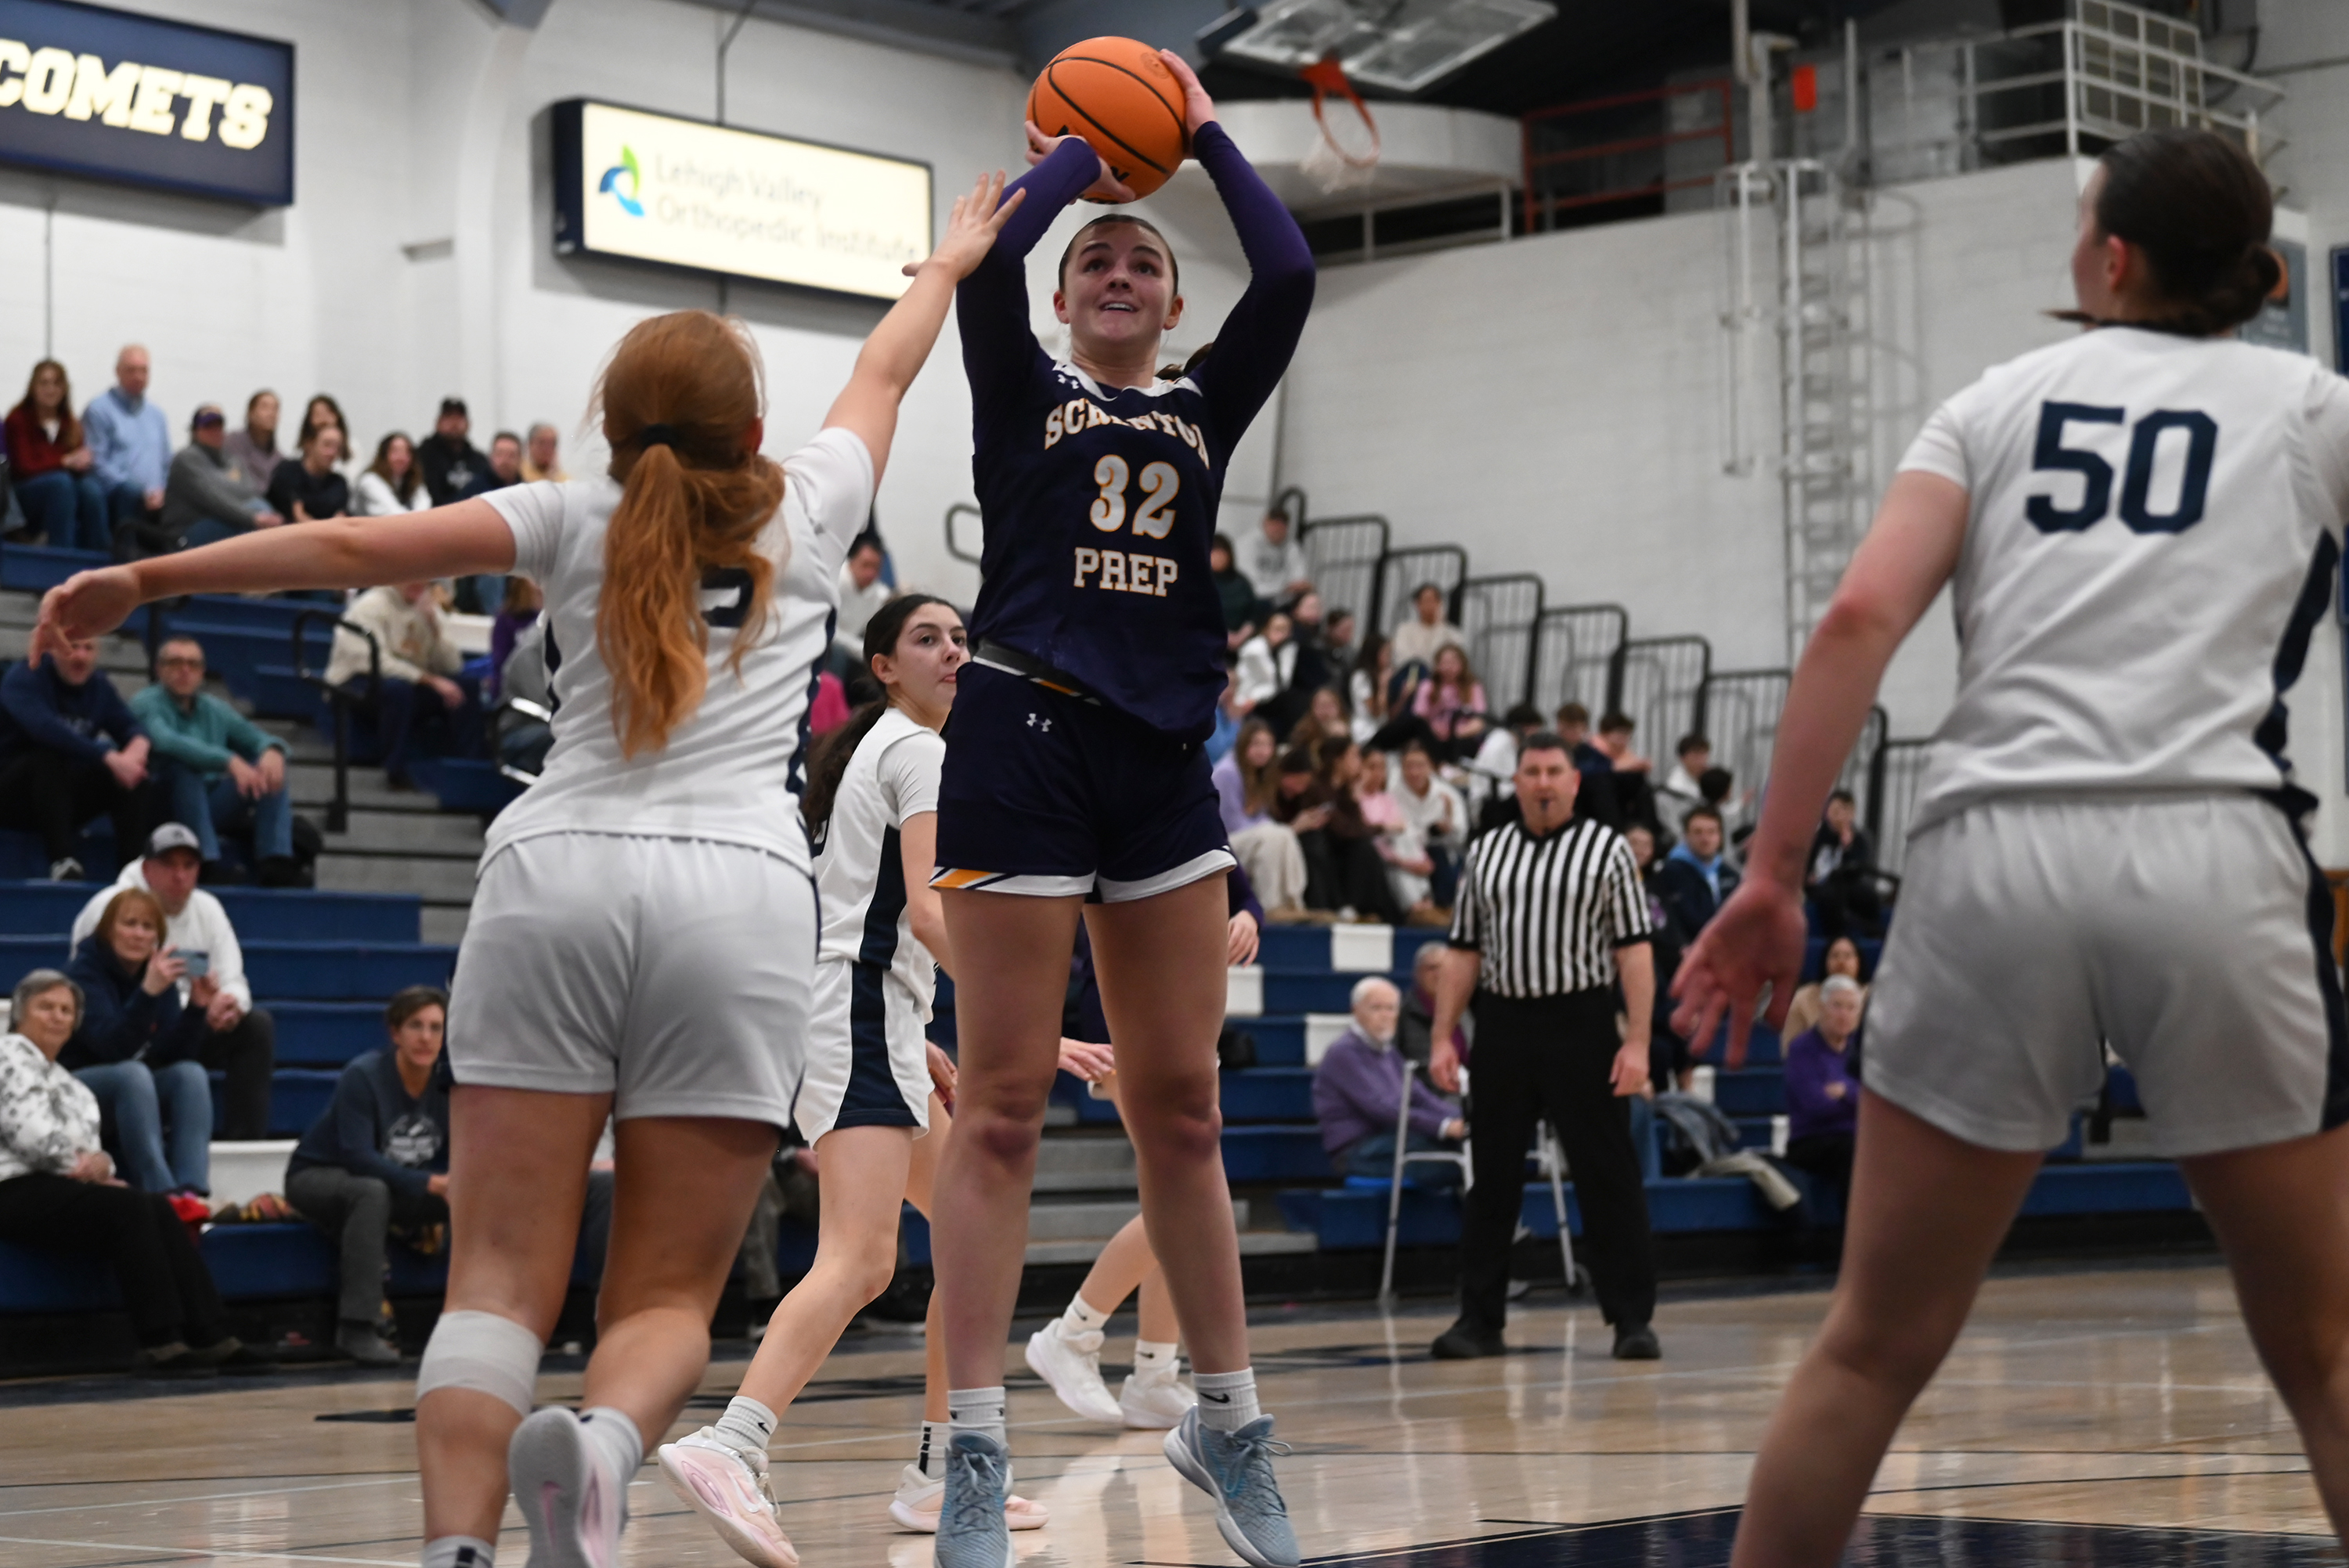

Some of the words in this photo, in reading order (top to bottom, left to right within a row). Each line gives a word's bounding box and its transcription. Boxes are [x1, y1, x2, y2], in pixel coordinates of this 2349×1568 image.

[0, 38, 273, 150] COMETS
[655, 153, 744, 200] Lehigh
[747, 168, 824, 216] Valley
[1090, 454, 1180, 539] 32
[2025, 400, 2218, 535] 50
[1073, 546, 1178, 597] PREP
